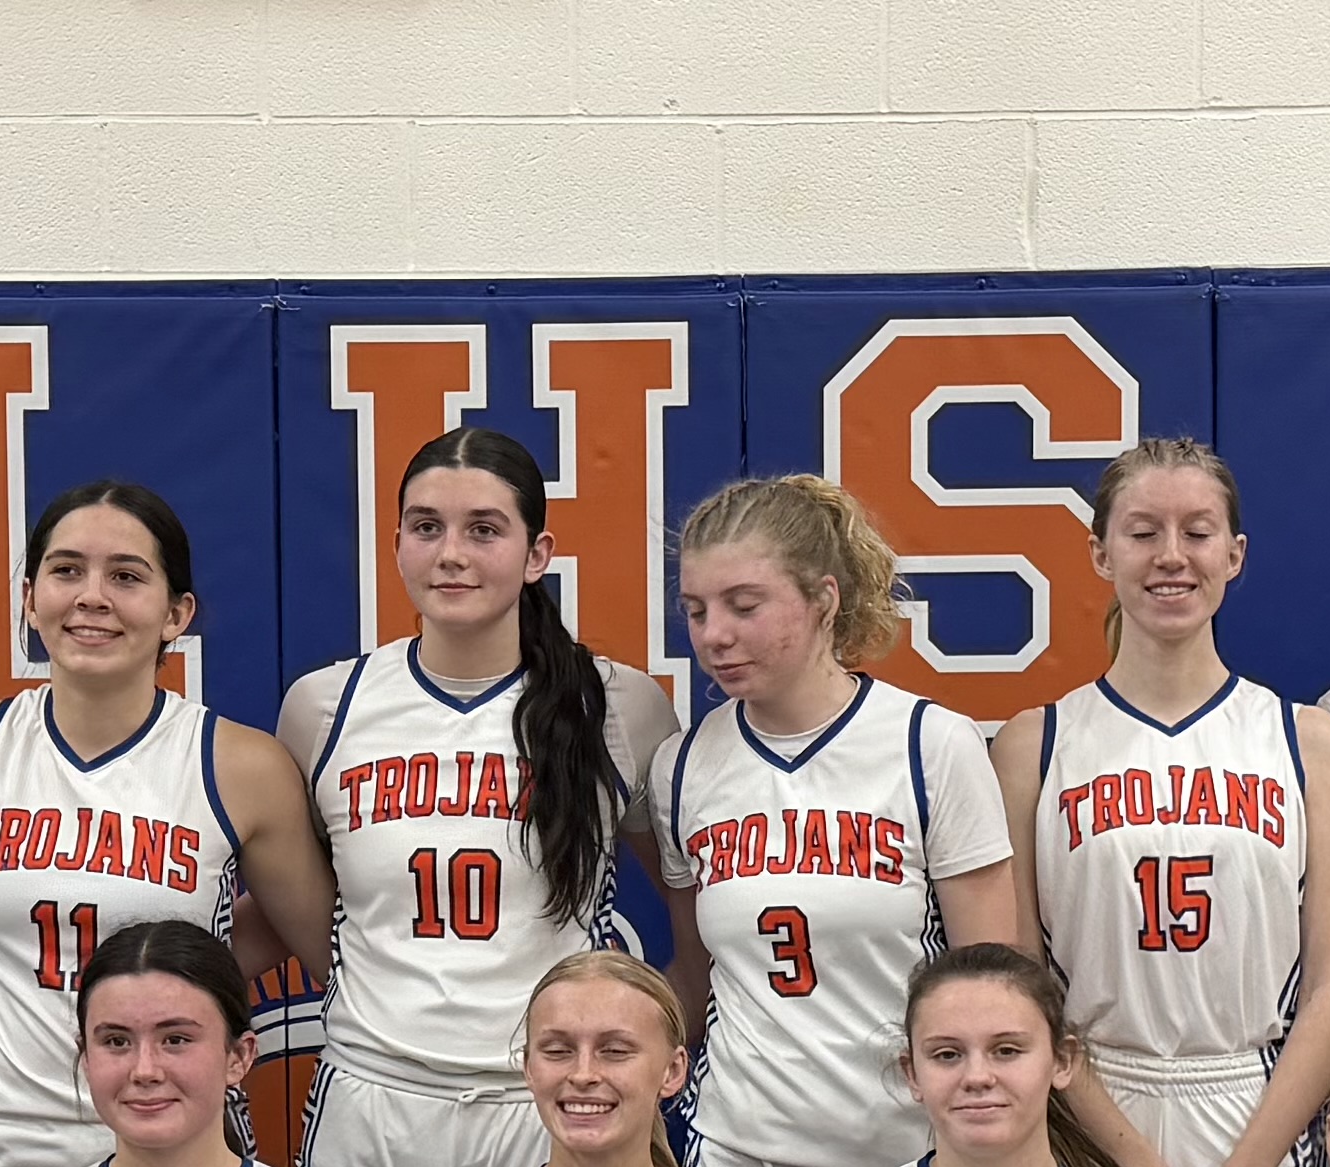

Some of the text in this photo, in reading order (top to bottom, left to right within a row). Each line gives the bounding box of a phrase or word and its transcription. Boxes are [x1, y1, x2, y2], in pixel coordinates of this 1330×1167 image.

[339, 751, 537, 832] TROJA
[1059, 765, 1285, 849] TROJANS
[408, 848, 502, 941] 10
[686, 809, 905, 893] TROJANS
[30, 900, 99, 991] 11
[1134, 855, 1214, 952] 15
[757, 906, 818, 998] 3
